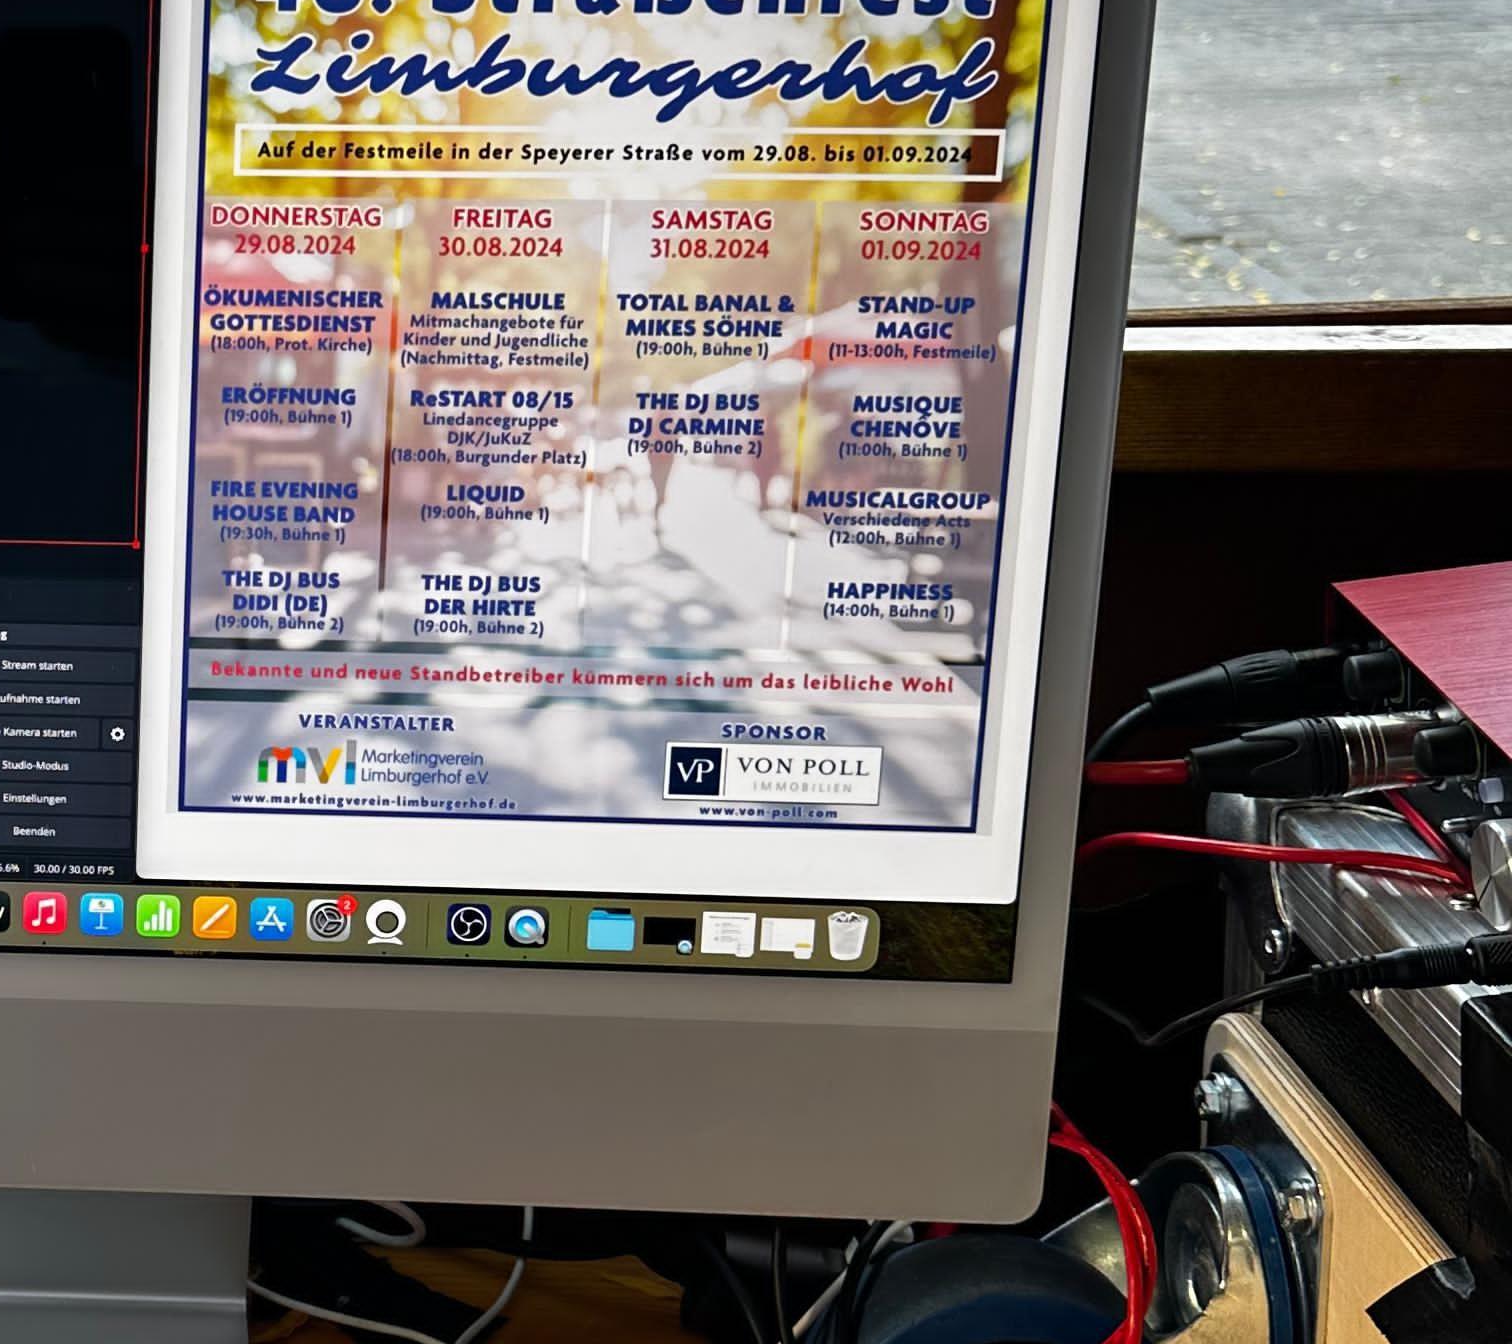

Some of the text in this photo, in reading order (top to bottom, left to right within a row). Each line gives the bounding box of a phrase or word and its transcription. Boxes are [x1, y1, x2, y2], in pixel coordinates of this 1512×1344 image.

[249, 31, 999, 127] Limburgerhof
[258, 142, 972, 166] Auf der Festmeile in der Speyerer Straße vom 29.08. bis 01.09.2024
[212, 206, 382, 227] DONNERSTAG
[452, 208, 553, 229] FREITAG
[651, 210, 773, 230] SAMSTAG
[860, 211, 988, 232] SONNTAG
[235, 234, 356, 255] 29.08.2024
[439, 237, 563, 257] 30.08.2024
[650, 239, 770, 259] 31.08.2024
[861, 241, 981, 261] 01.09.2024
[204, 284, 384, 308] ÖKUMENISCHER
[431, 292, 565, 310] MALSCHULE
[617, 294, 795, 313] TOTAL BANAL &
[858, 296, 976, 315] STAND-UP
[210, 314, 376, 332] GOTTESDIENST
[410, 315, 584, 333] Mitmachangebote für
[625, 314, 783, 338] MIKES SÖHNE
[875, 322, 953, 340] MAGIC
[404, 332, 589, 351] Kinder und Jugendliche
[221, 382, 356, 406] ERÖFFNUNG
[410, 390, 574, 411] ReSTART 08/15
[636, 393, 760, 414] THE DJ BUS
[853, 395, 963, 418] MUSIQUE
[424, 412, 559, 430] Linedancegruppe
[628, 418, 765, 438] DJ CARMINE
[850, 415, 961, 439] CHENÔVE
[447, 430, 532, 448] DJK/JuKuZ
[211, 481, 358, 499] FIRE EVENING
[446, 485, 525, 505] LIQUID
[806, 490, 990, 510] MUSICALGROUP
[212, 505, 355, 524] HOUSE BAND
[222, 570, 340, 591] THE DJ BUS
[827, 583, 953, 600] HAPPINESS
[232, 594, 328, 616] DIDI (DE)
[1, 660, 73, 672] Stream starten
[211, 662, 953, 693] Bekannte und neue Standbetreiber kümmern sich um das leibliche Wohl
[46, 695, 80, 705] starten
[299, 714, 455, 732] VERANSTALTER
[721, 724, 827, 740] SPONSOR
[2, 760, 69, 772] Studio-Modus
[361, 749, 484, 767] Marketingverein
[737, 757, 870, 777] VON POLL
[361, 768, 461, 785] Limburgerhof
[676, 758, 714, 784] VP
[753, 781, 852, 794] IMMOBILIEN
[2, 794, 67, 806] Einstellungen
[231, 792, 516, 810] www.marketingverein-limburgerhof.de
[13, 827, 56, 838] Beenden
